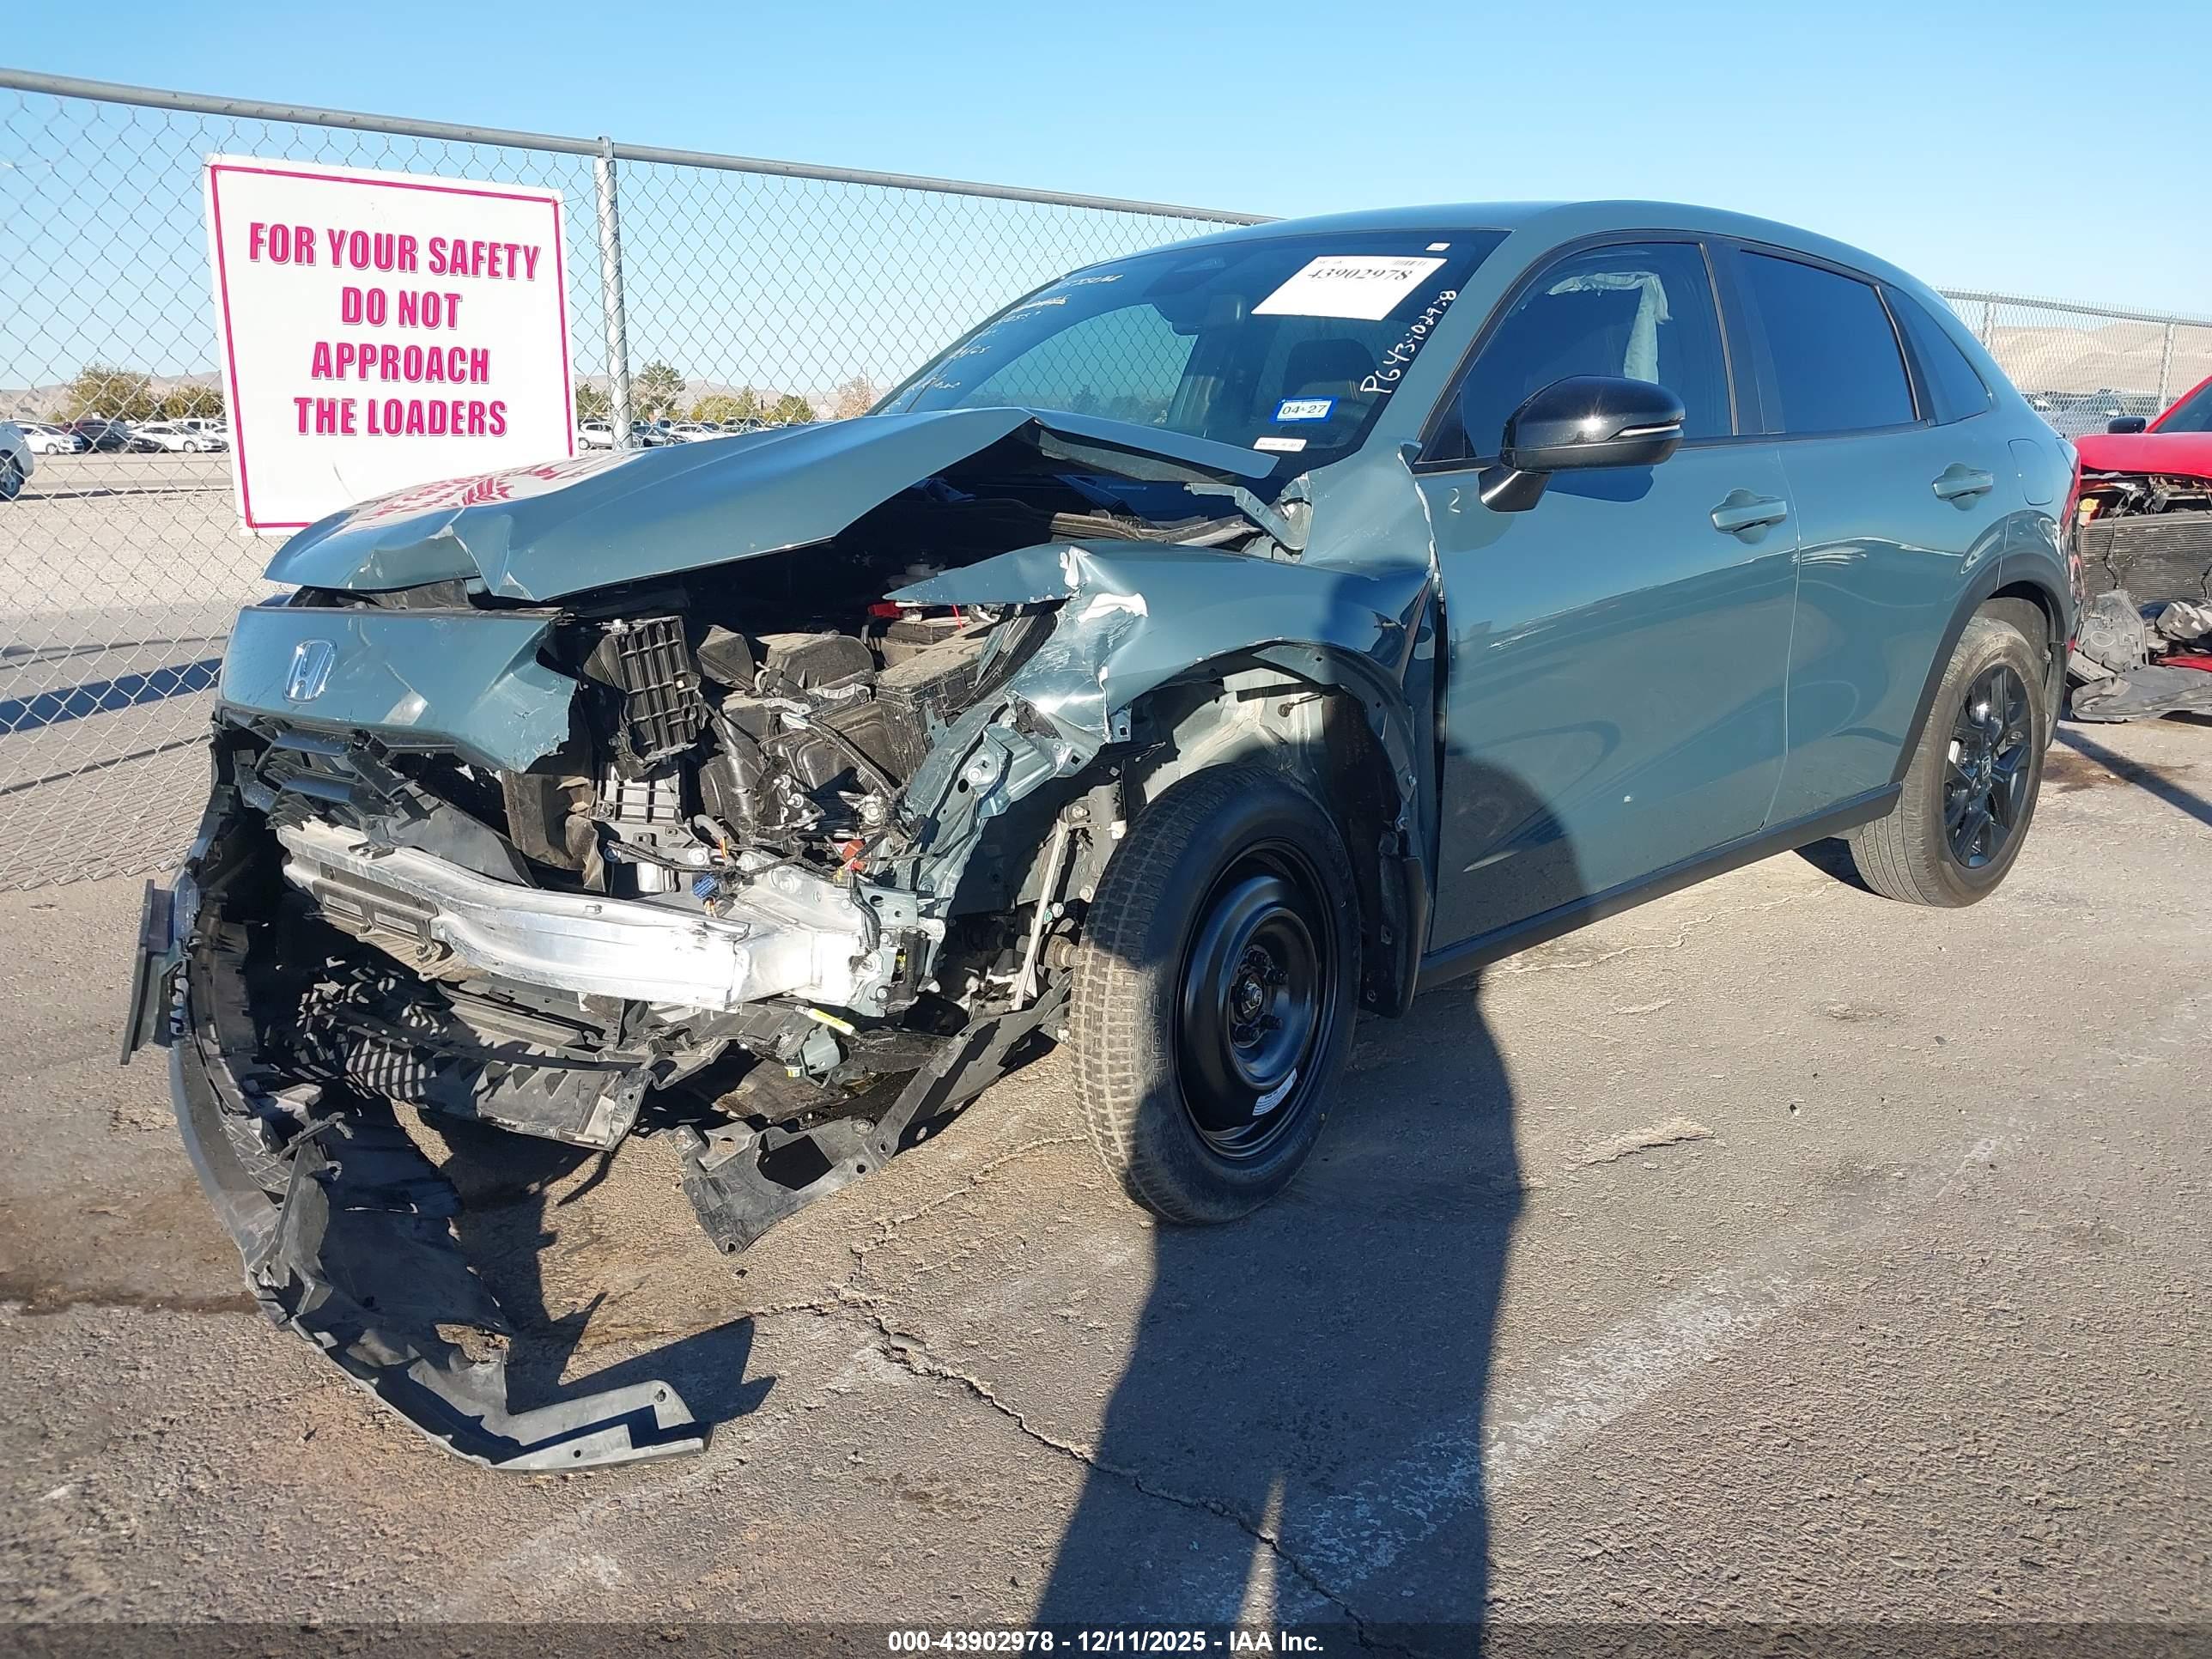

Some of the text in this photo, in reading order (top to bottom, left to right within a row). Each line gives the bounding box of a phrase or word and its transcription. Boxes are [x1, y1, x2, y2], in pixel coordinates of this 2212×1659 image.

[249, 222, 542, 281] FOR YOUR SAFETY
[1307, 268, 1413, 281] 43902978
[340, 286, 463, 330] DO NOT
[310, 341, 491, 385] APPROACH
[293, 397, 507, 437] THE LOADERS
